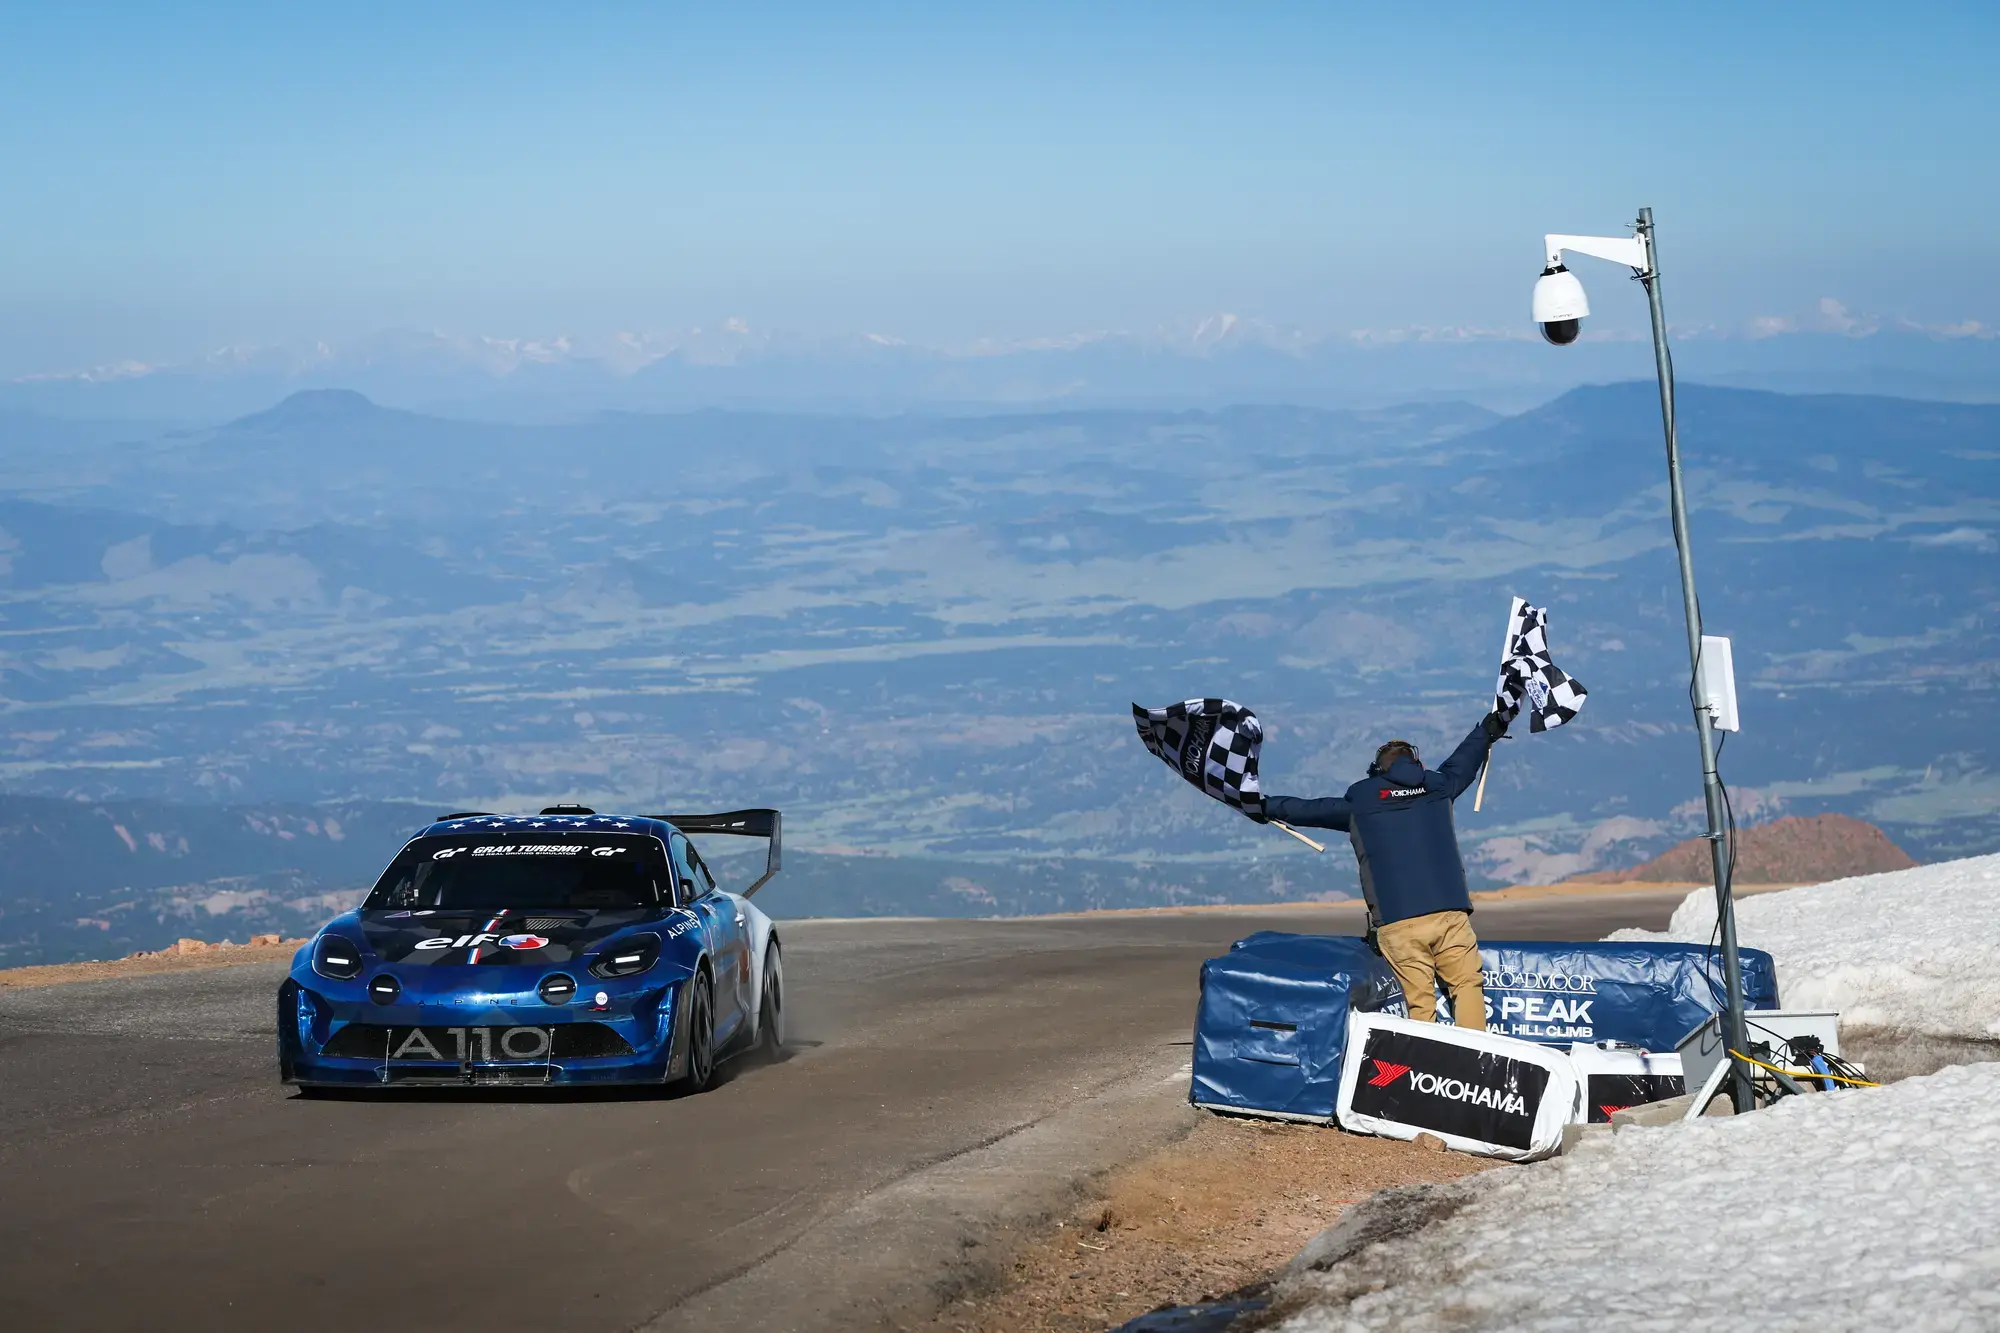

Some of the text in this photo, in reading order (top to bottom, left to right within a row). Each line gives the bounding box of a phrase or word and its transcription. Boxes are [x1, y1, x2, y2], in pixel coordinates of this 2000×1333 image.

[1390, 787, 1426, 797] YOKOHAMA
[473, 845, 583, 854] GRAN TURISMO
[667, 919, 698, 940] ALPINE
[414, 933, 500, 950] elf
[1500, 964, 1517, 972] THE
[1482, 969, 1596, 992] BROADMOOR
[1501, 996, 1594, 1024] PEAK
[1512, 1024, 1544, 1036] HILL
[1546, 1025, 1594, 1038] CLIMB
[391, 1026, 550, 1061] A110
[1409, 1070, 1527, 1117] YOKOHAMA
